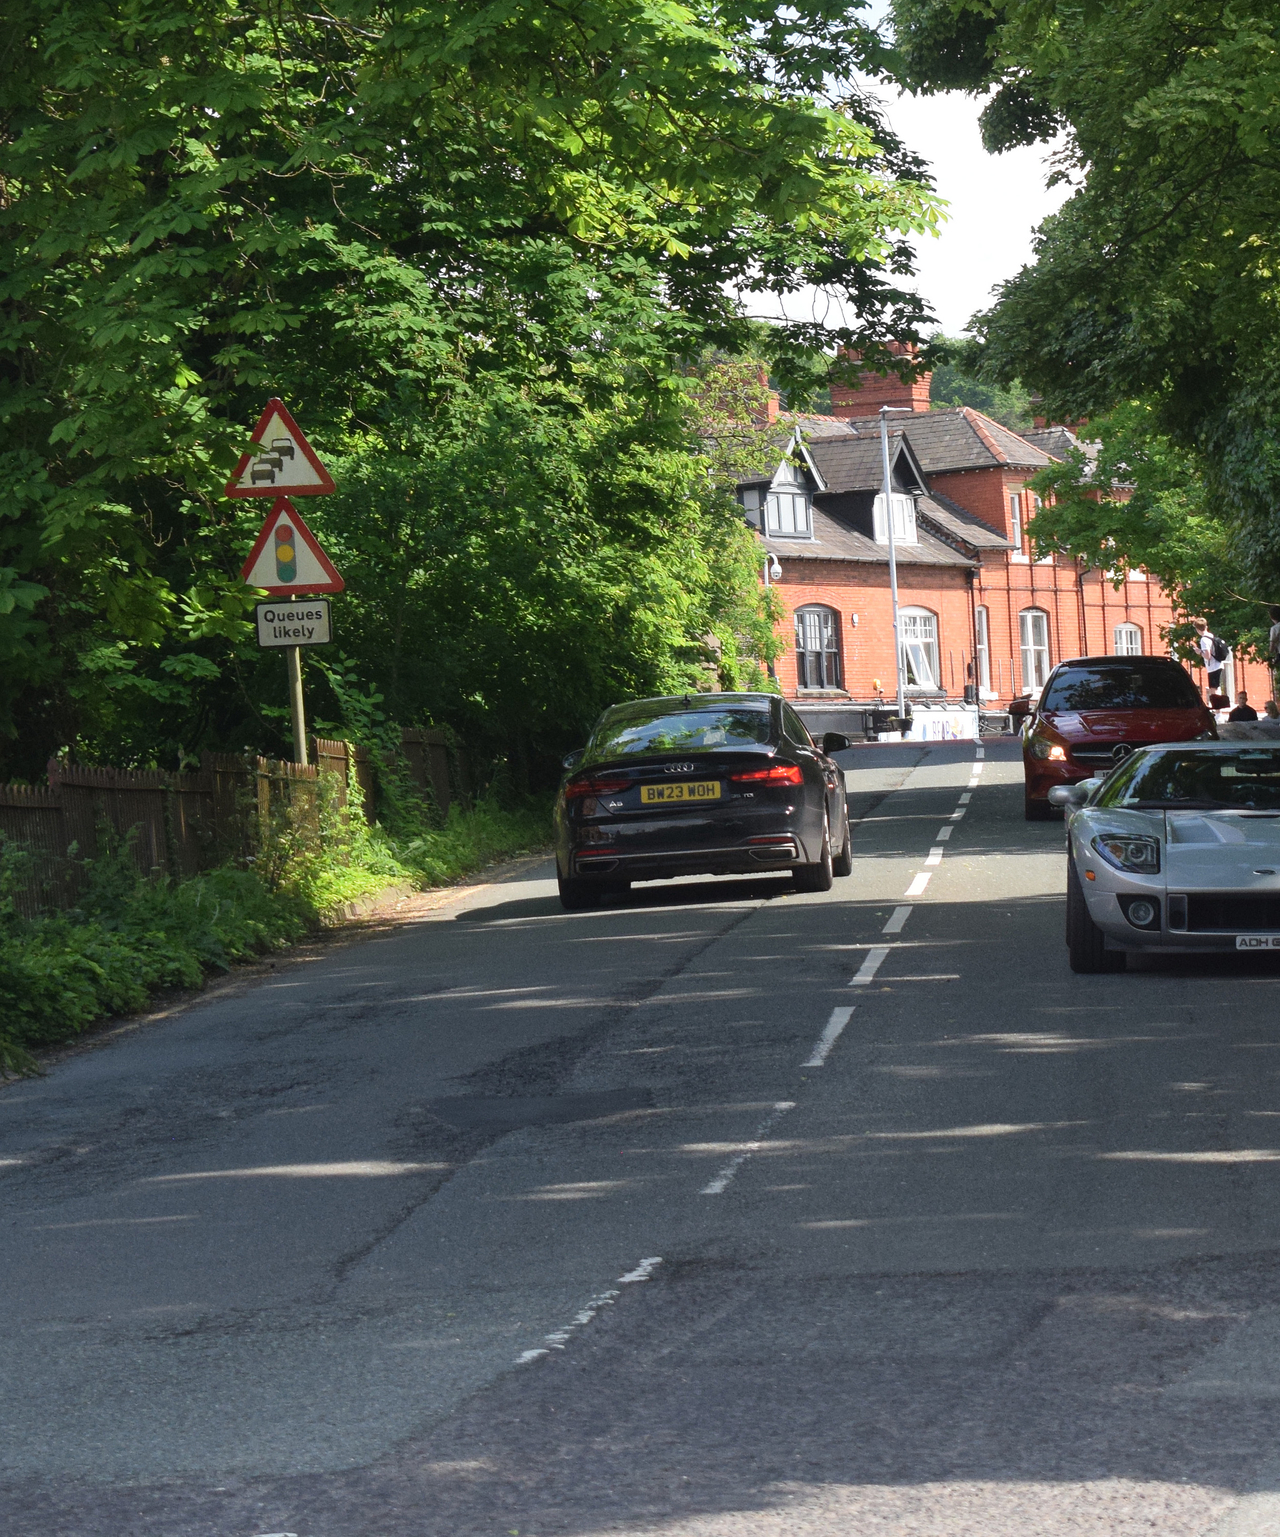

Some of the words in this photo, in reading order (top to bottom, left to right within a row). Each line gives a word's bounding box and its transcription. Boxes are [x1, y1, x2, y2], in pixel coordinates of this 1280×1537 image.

[263, 609, 323, 623] Queues
[273, 624, 315, 639] likely
[647, 786, 684, 800] BW23
[687, 784, 715, 797] WOH
[1239, 938, 1268, 947] ADH
